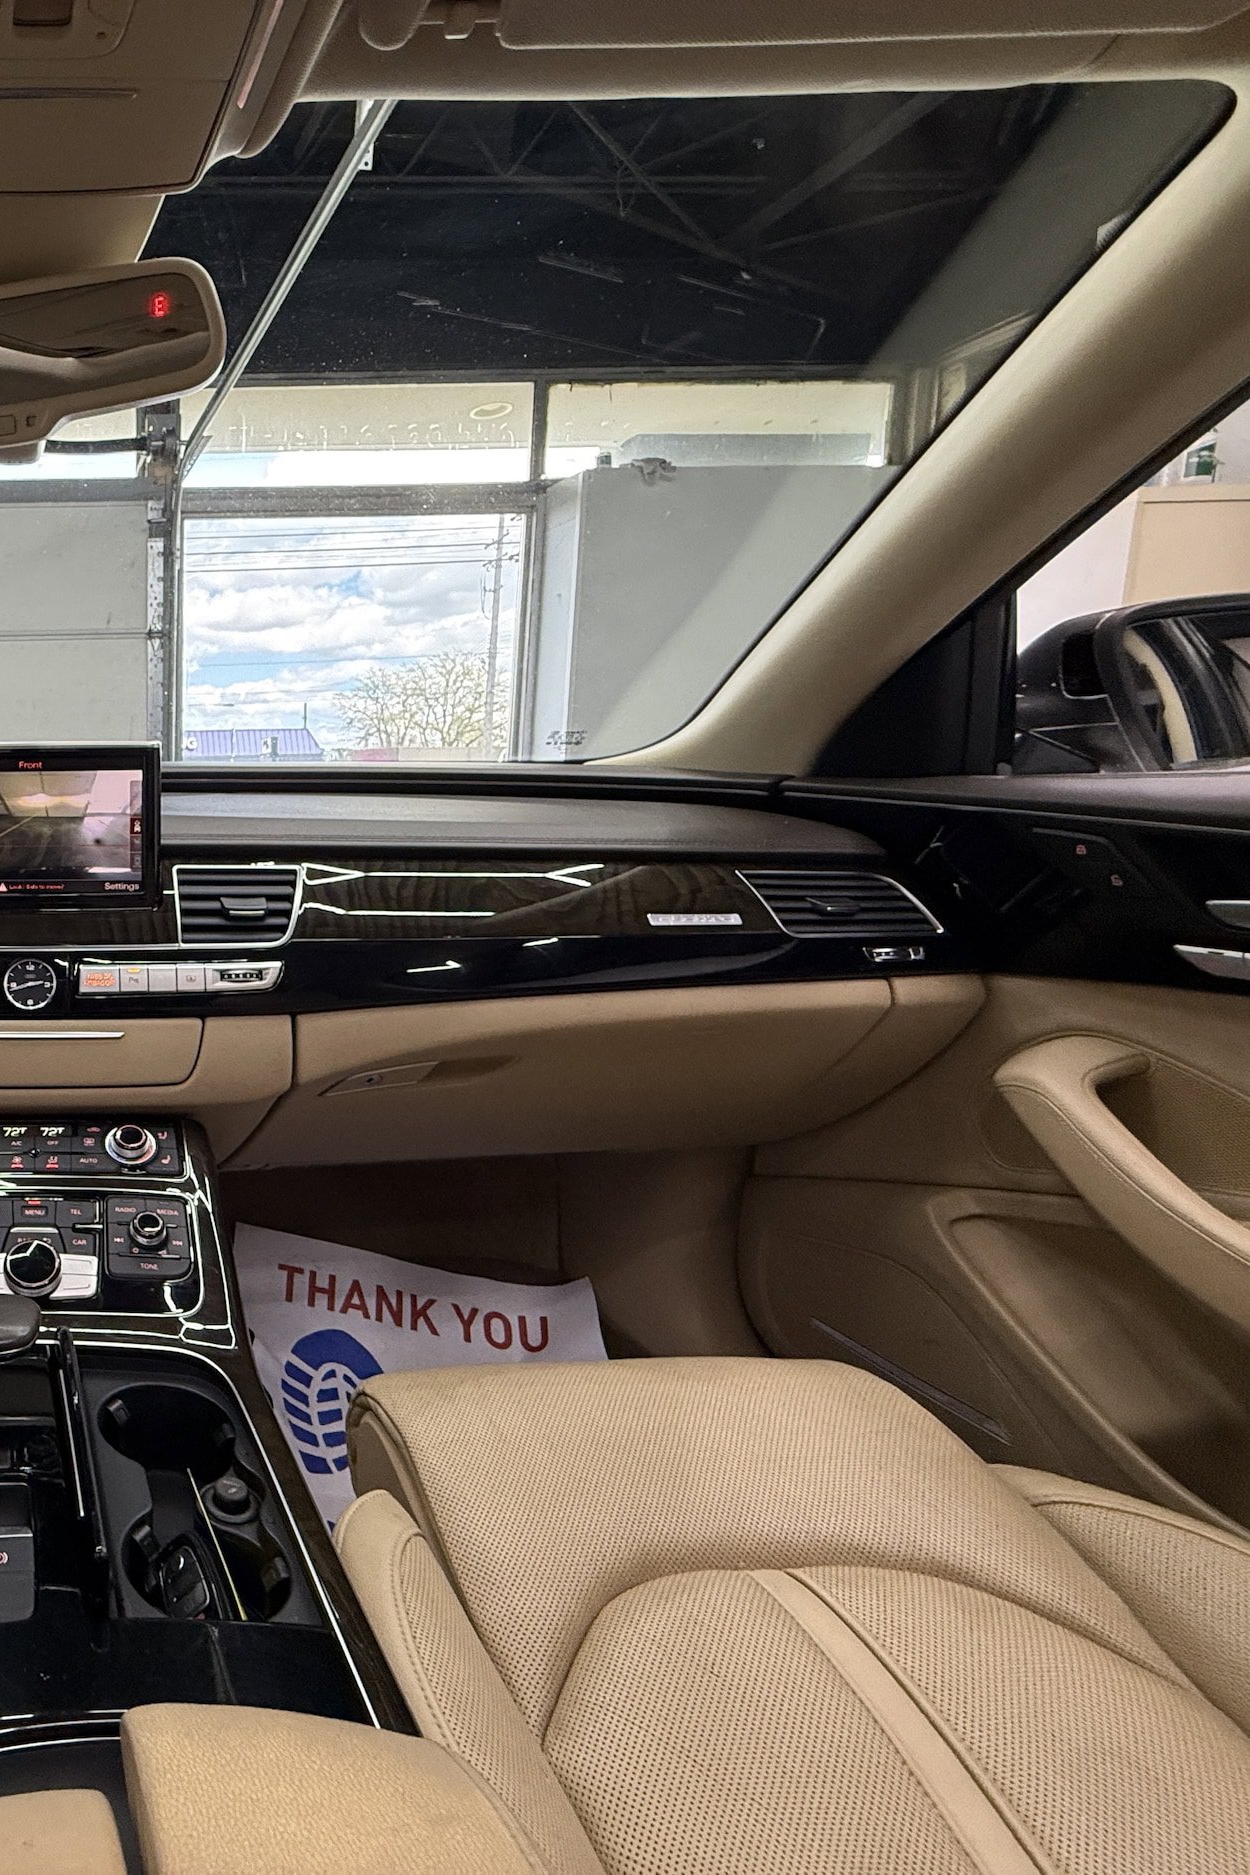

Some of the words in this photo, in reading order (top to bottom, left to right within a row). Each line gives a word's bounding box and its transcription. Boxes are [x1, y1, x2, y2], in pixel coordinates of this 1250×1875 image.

[18, 760, 42, 769] Front
[104, 882, 140, 892] Settings
[156, 1208, 180, 1216] MEDIA
[72, 1238, 87, 1246] CAR
[277, 1263, 440, 1337] THANK
[452, 1302, 549, 1353] YOU
